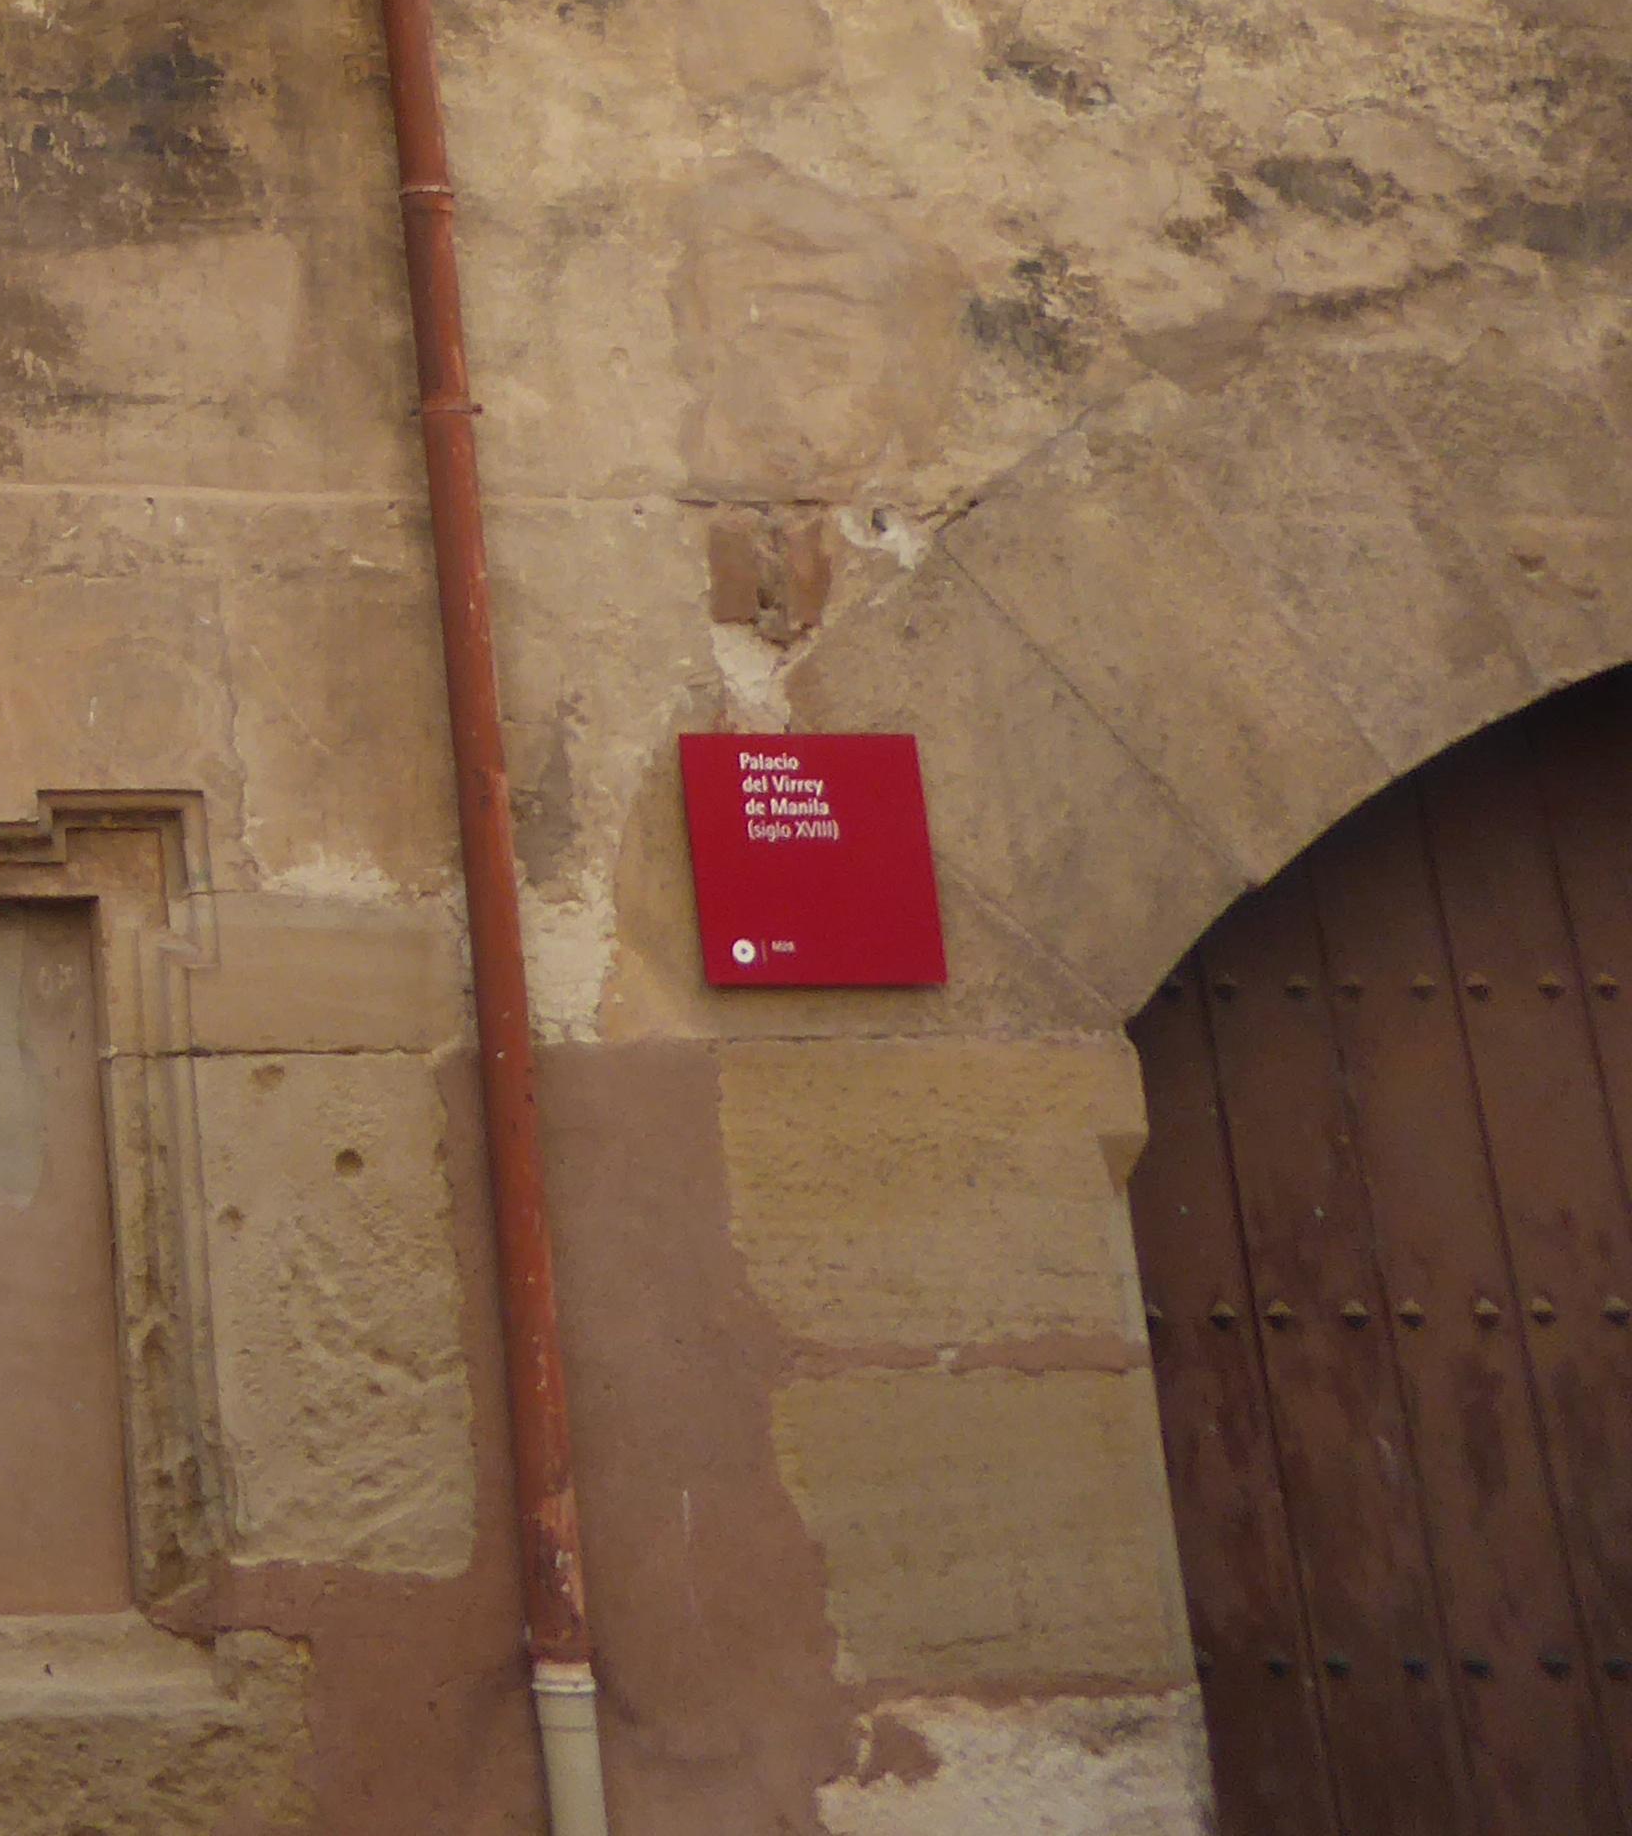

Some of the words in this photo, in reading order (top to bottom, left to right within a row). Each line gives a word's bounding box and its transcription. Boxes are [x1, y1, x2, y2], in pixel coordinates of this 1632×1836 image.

[739, 752, 800, 770] Palacio
[742, 775, 768, 793] del
[772, 775, 824, 796] Virrey
[745, 798, 766, 816] de
[770, 798, 830, 816] Manila
[748, 819, 792, 842] (siglo
[795, 819, 840, 840] XVIII)
